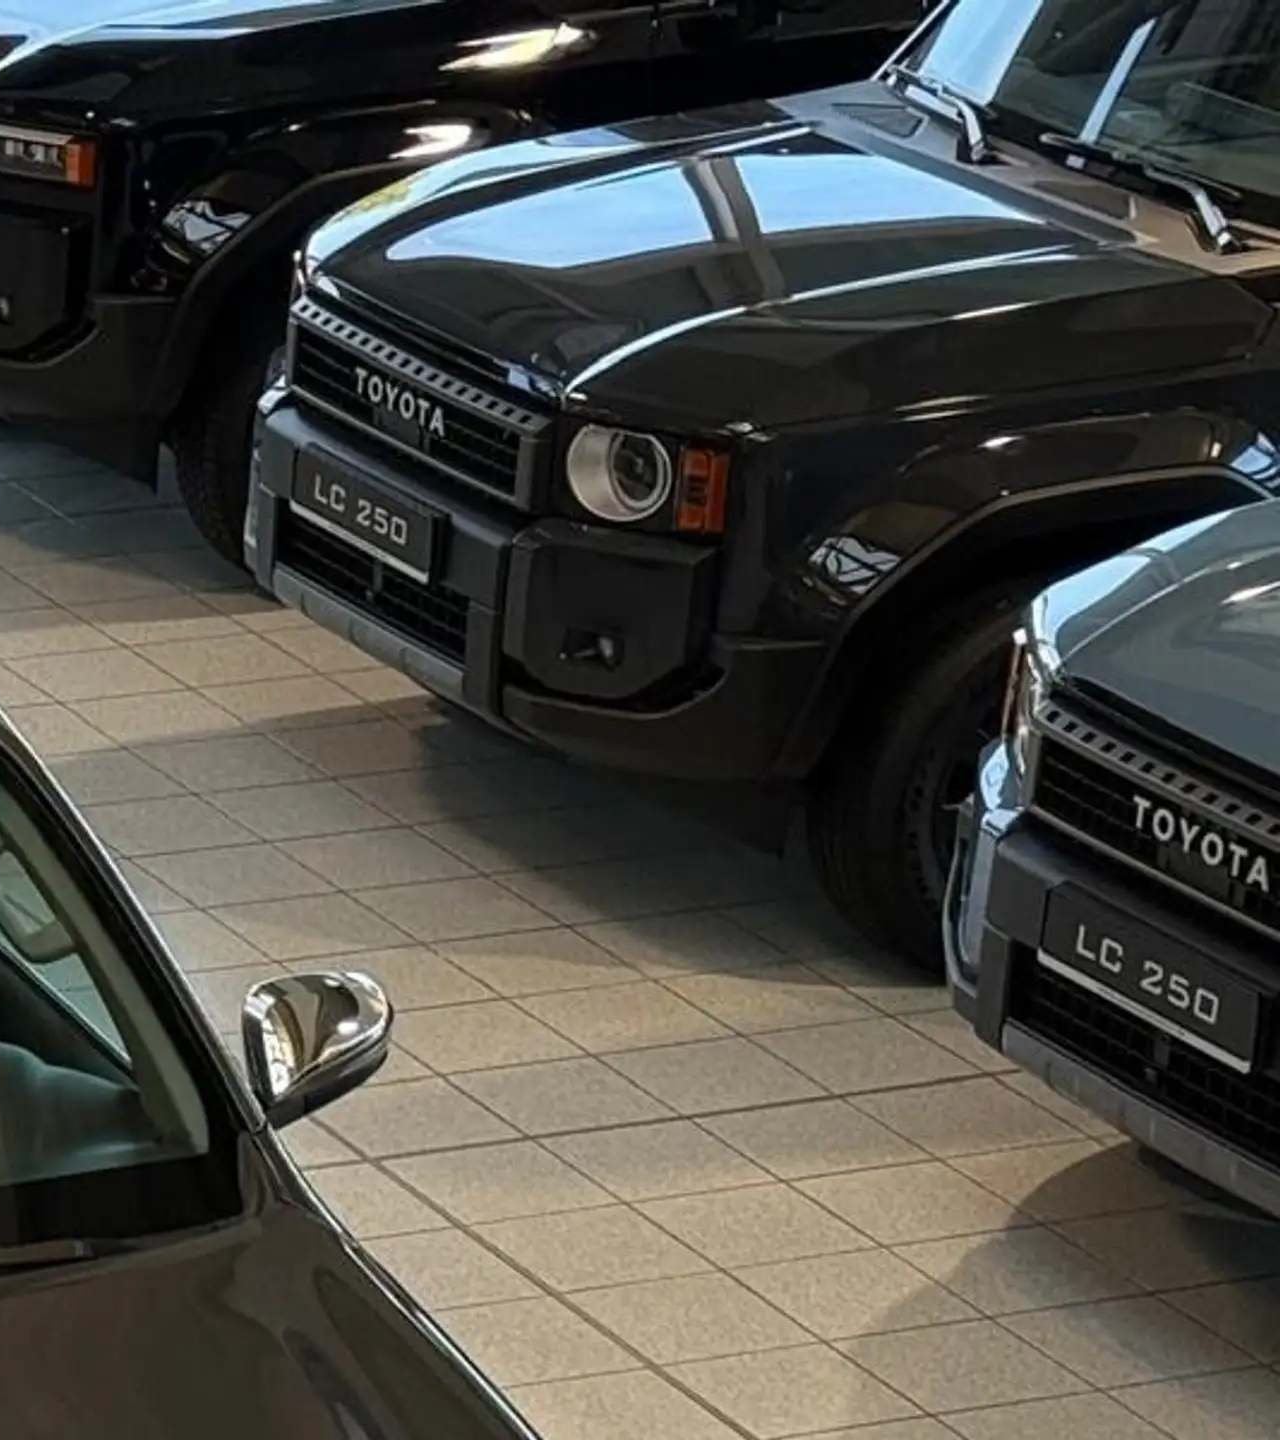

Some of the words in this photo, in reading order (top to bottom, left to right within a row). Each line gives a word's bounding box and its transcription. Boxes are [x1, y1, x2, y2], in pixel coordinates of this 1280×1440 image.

[355, 366, 444, 437] TOYOTA
[314, 475, 346, 512] LC
[356, 498, 408, 547] 250
[1133, 795, 1269, 893] TOYOTA
[1076, 923, 1123, 974] LC
[1140, 960, 1220, 1024] 250
